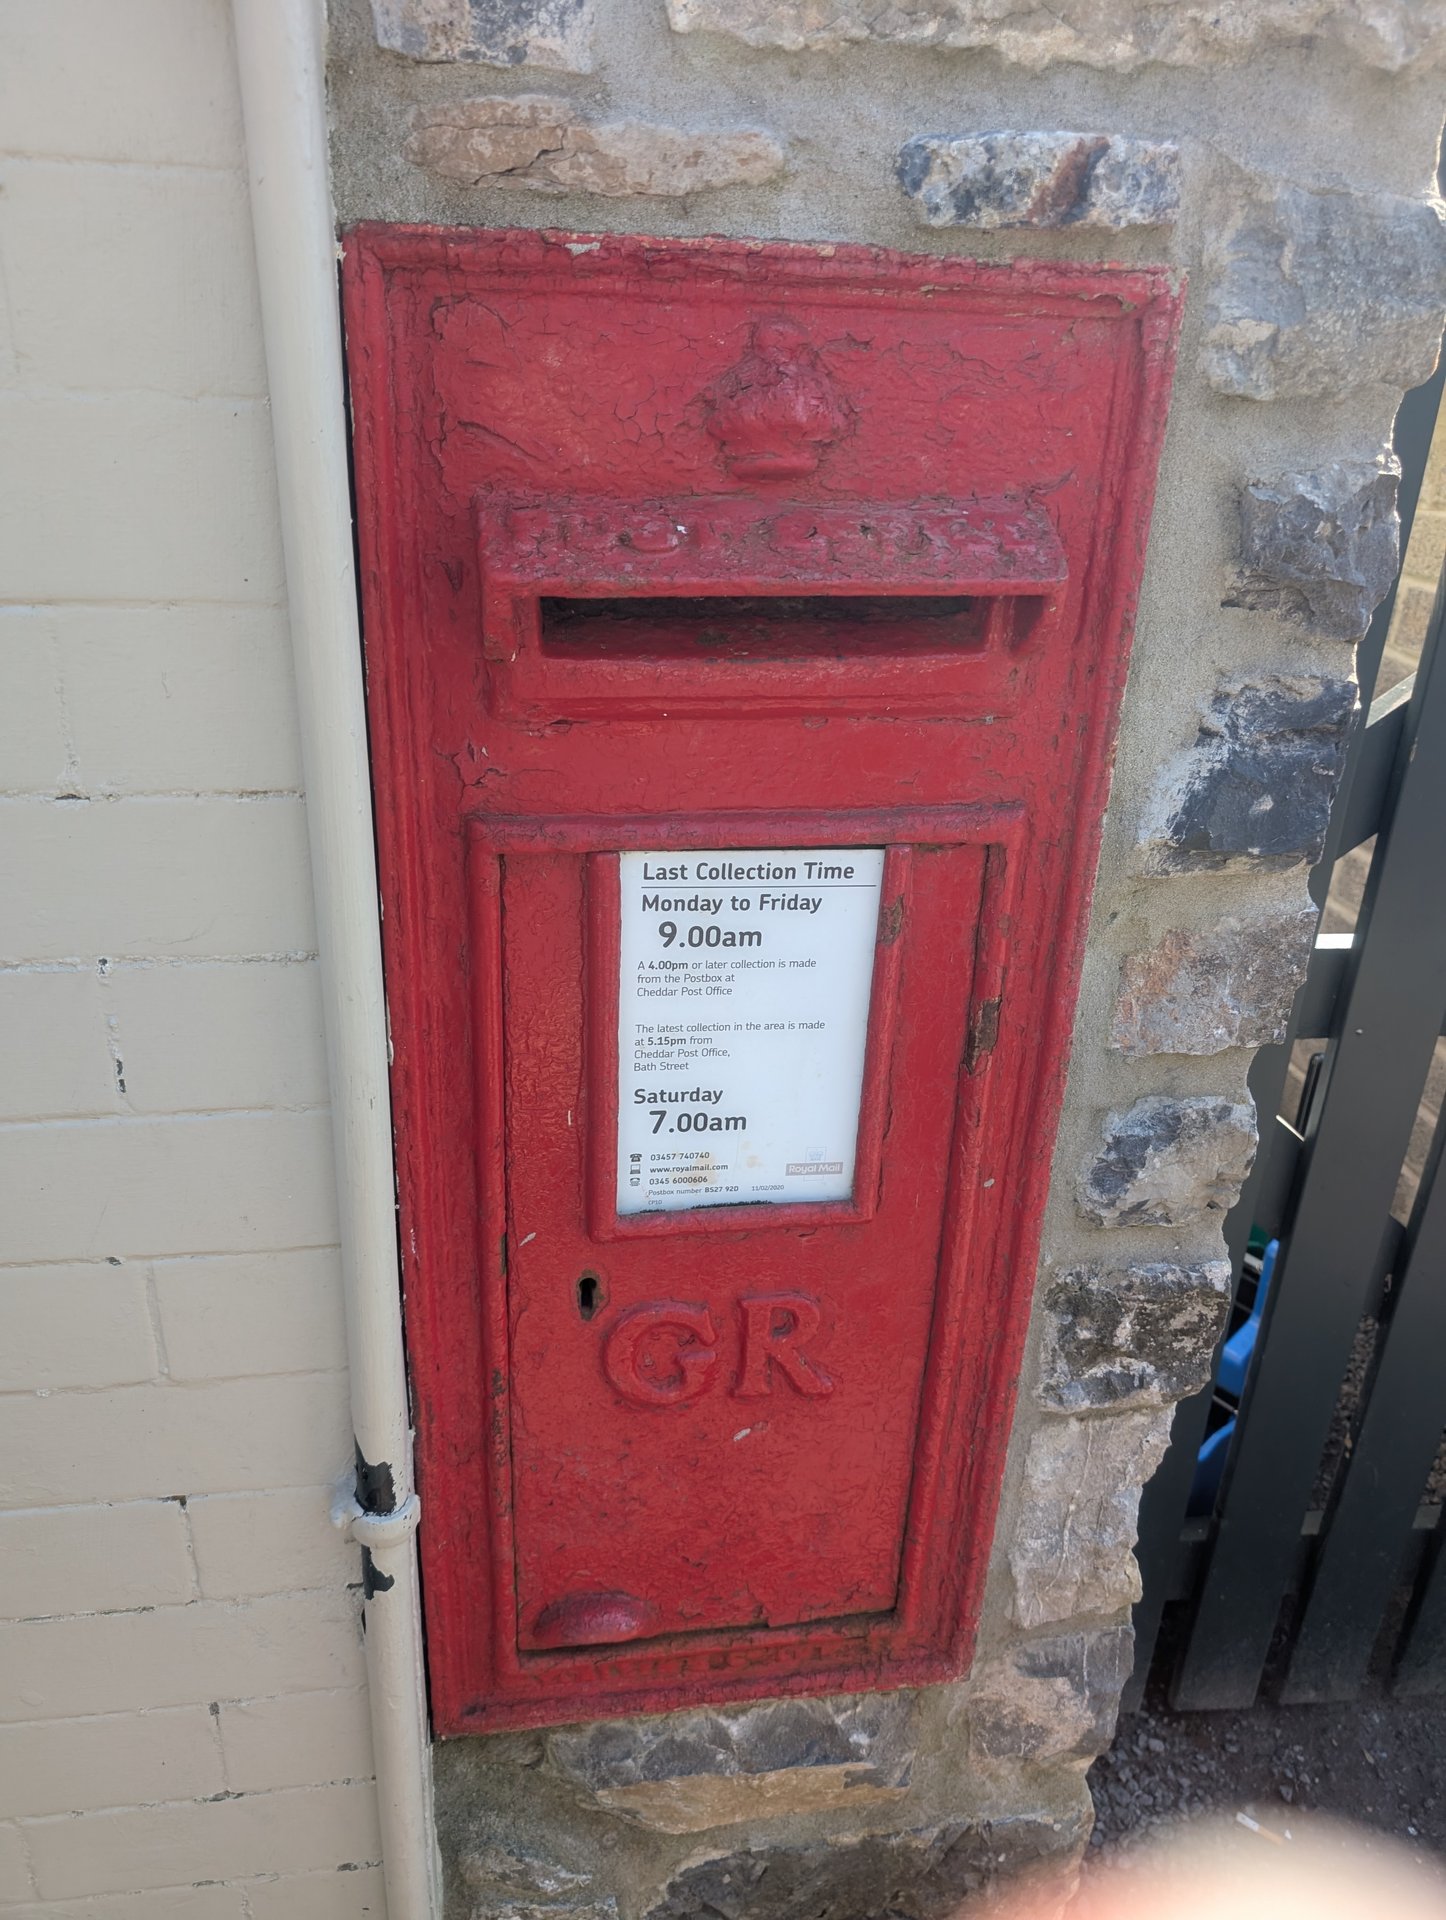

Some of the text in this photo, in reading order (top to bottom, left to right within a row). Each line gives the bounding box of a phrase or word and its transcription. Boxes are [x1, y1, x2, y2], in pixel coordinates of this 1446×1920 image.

[643, 862, 854, 880] Last Collection Time
[642, 893, 822, 915] Monday to Friday
[658, 921, 762, 948] 9.00am
[638, 961, 645, 970] A
[648, 960, 688, 972] 4.00pm
[705, 960, 728, 969] later
[730, 960, 775, 969] collection
[779, 960, 786, 968] is
[789, 959, 816, 968] made
[638, 973, 735, 983] from the Postbox at
[637, 986, 732, 997] Cheddar Post Office
[635, 1020, 825, 1033] The latest collection in the area is made
[634, 1036, 712, 1048] at 5.15pm from
[634, 1048, 730, 1059] Cheddar Post Office,
[634, 1061, 689, 1071] Bath Street
[634, 1087, 723, 1104] Saturday
[649, 1110, 747, 1134] 7.00am
[650, 1152, 710, 1161] 03457 740740
[650, 1164, 728, 1174] www.royalmail.com
[788, 1164, 840, 1174] Royal Mail
[649, 1176, 708, 1185] 0345 6000606
[602, 1291, 835, 1404] GR
